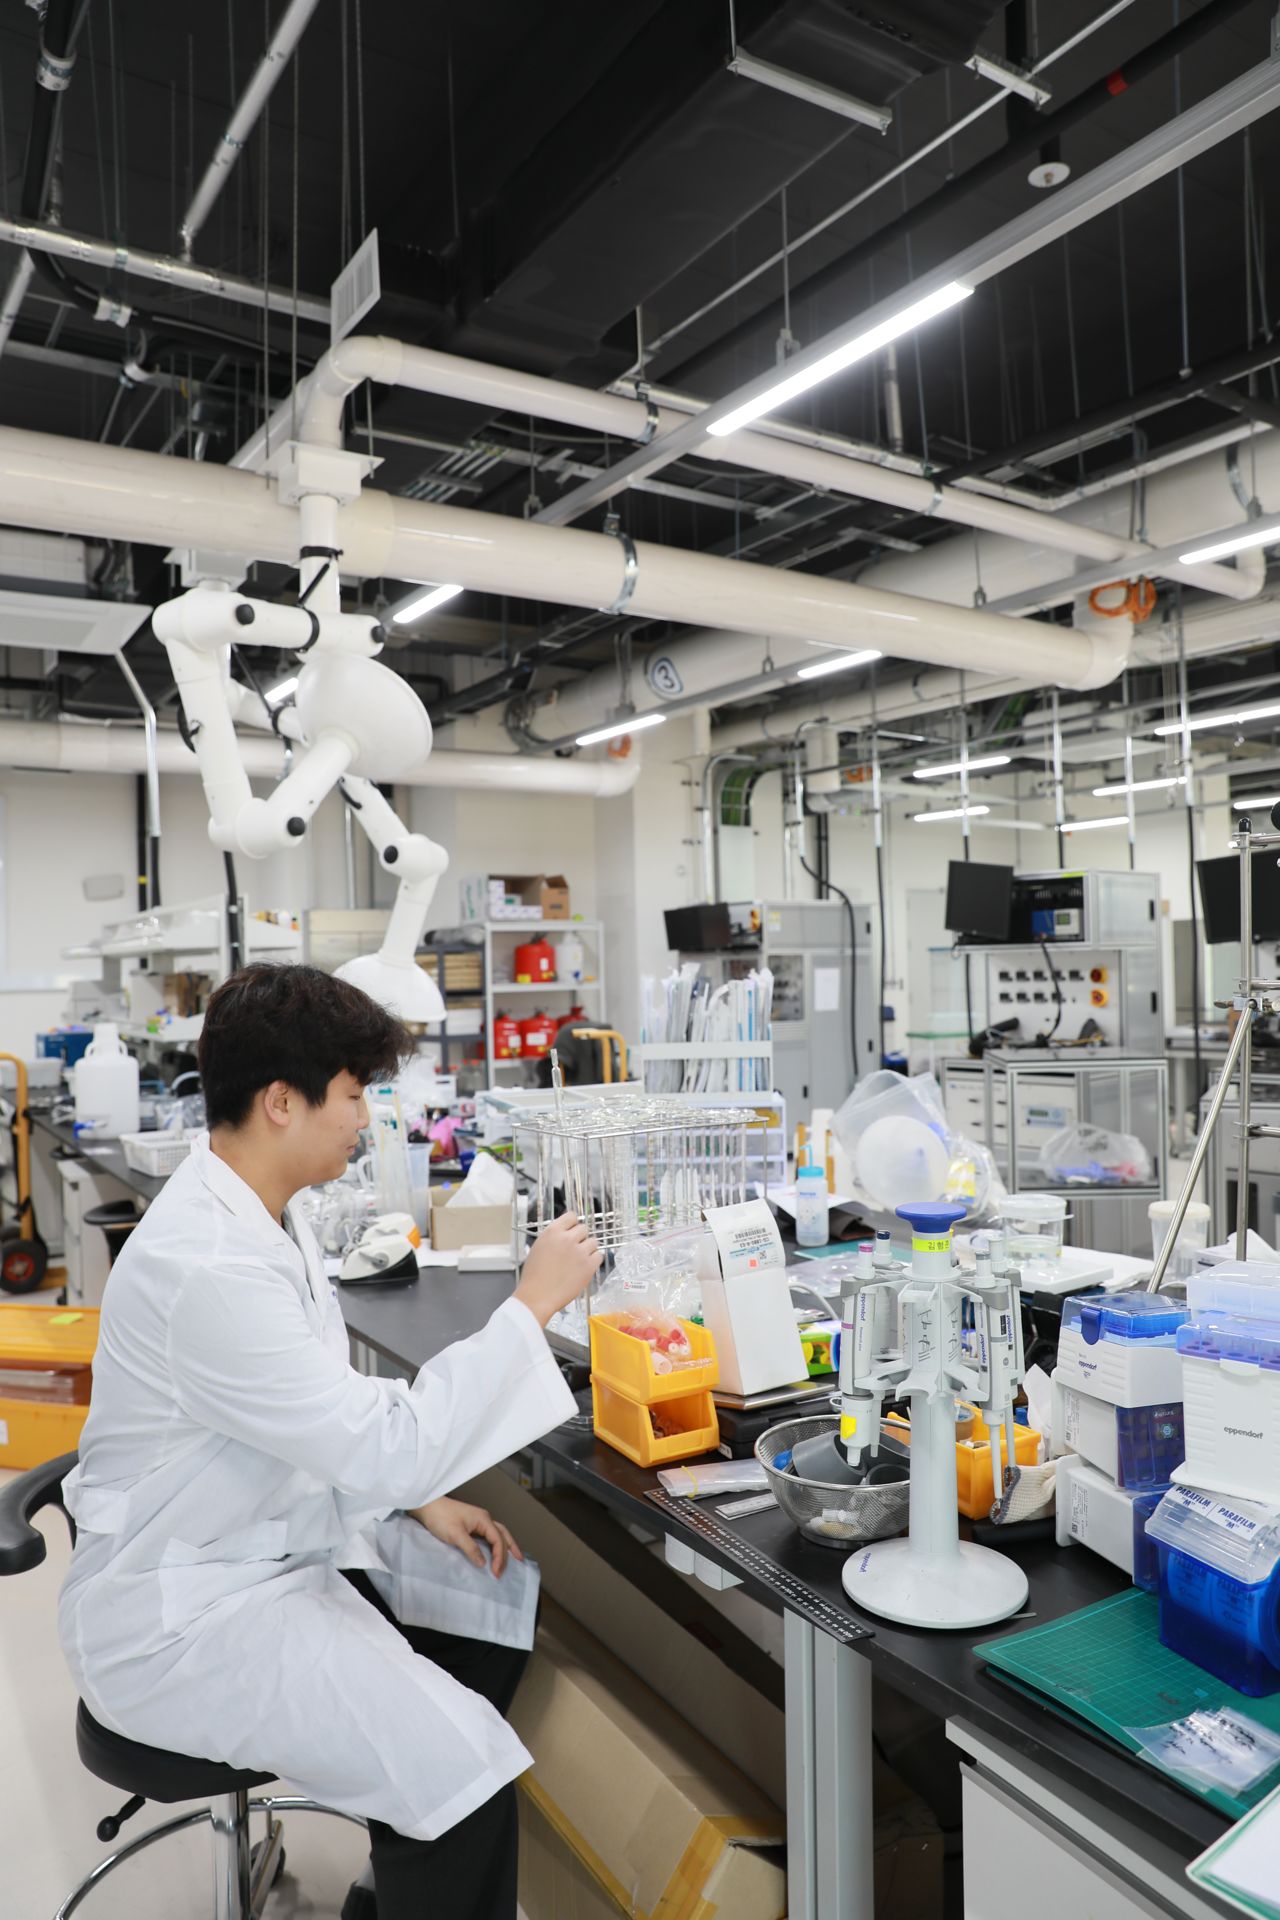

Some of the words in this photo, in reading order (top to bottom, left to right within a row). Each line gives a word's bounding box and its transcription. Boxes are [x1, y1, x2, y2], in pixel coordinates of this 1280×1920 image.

[657, 664, 676, 690] 3
[1078, 1360, 1097, 1371] eppendorf
[1223, 1426, 1264, 1440] eppendorf
[1175, 1486, 1212, 1507] PARAFILM
[1217, 1507, 1257, 1530] PARAFILM
